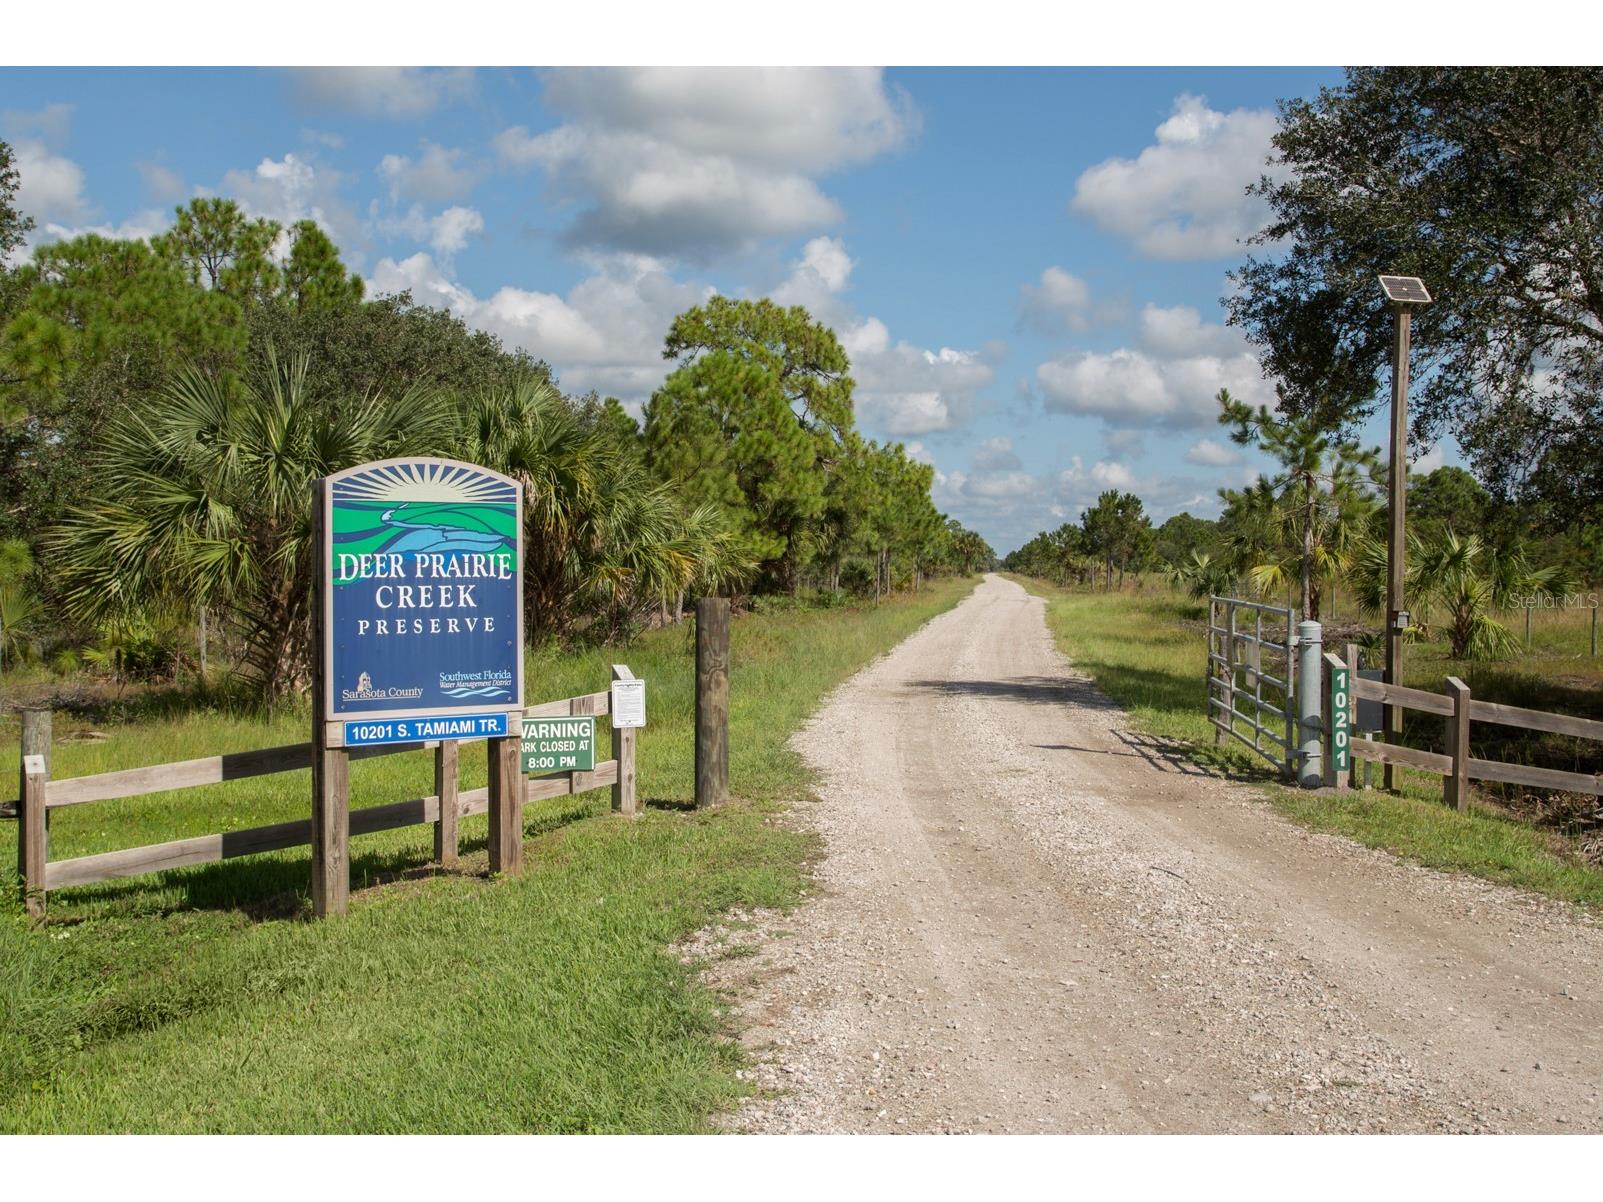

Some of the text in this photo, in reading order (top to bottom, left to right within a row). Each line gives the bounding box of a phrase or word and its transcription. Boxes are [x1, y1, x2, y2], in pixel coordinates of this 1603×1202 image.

[339, 552, 512, 580] DEER PRAIRIE
[376, 584, 477, 608] CREEK
[358, 617, 495, 635] PRESERVE
[439, 670, 512, 681] Southwest Florida
[456, 680, 491, 689] Management
[491, 679, 512, 687] District
[342, 686, 423, 700] Sarasota County
[1334, 672, 1348, 768] 10201
[352, 719, 501, 740] 10201 S. TAMIAMI TR.
[522, 740, 590, 753] ARK CLOSED AT
[528, 756, 576, 768] 8:00 PM
